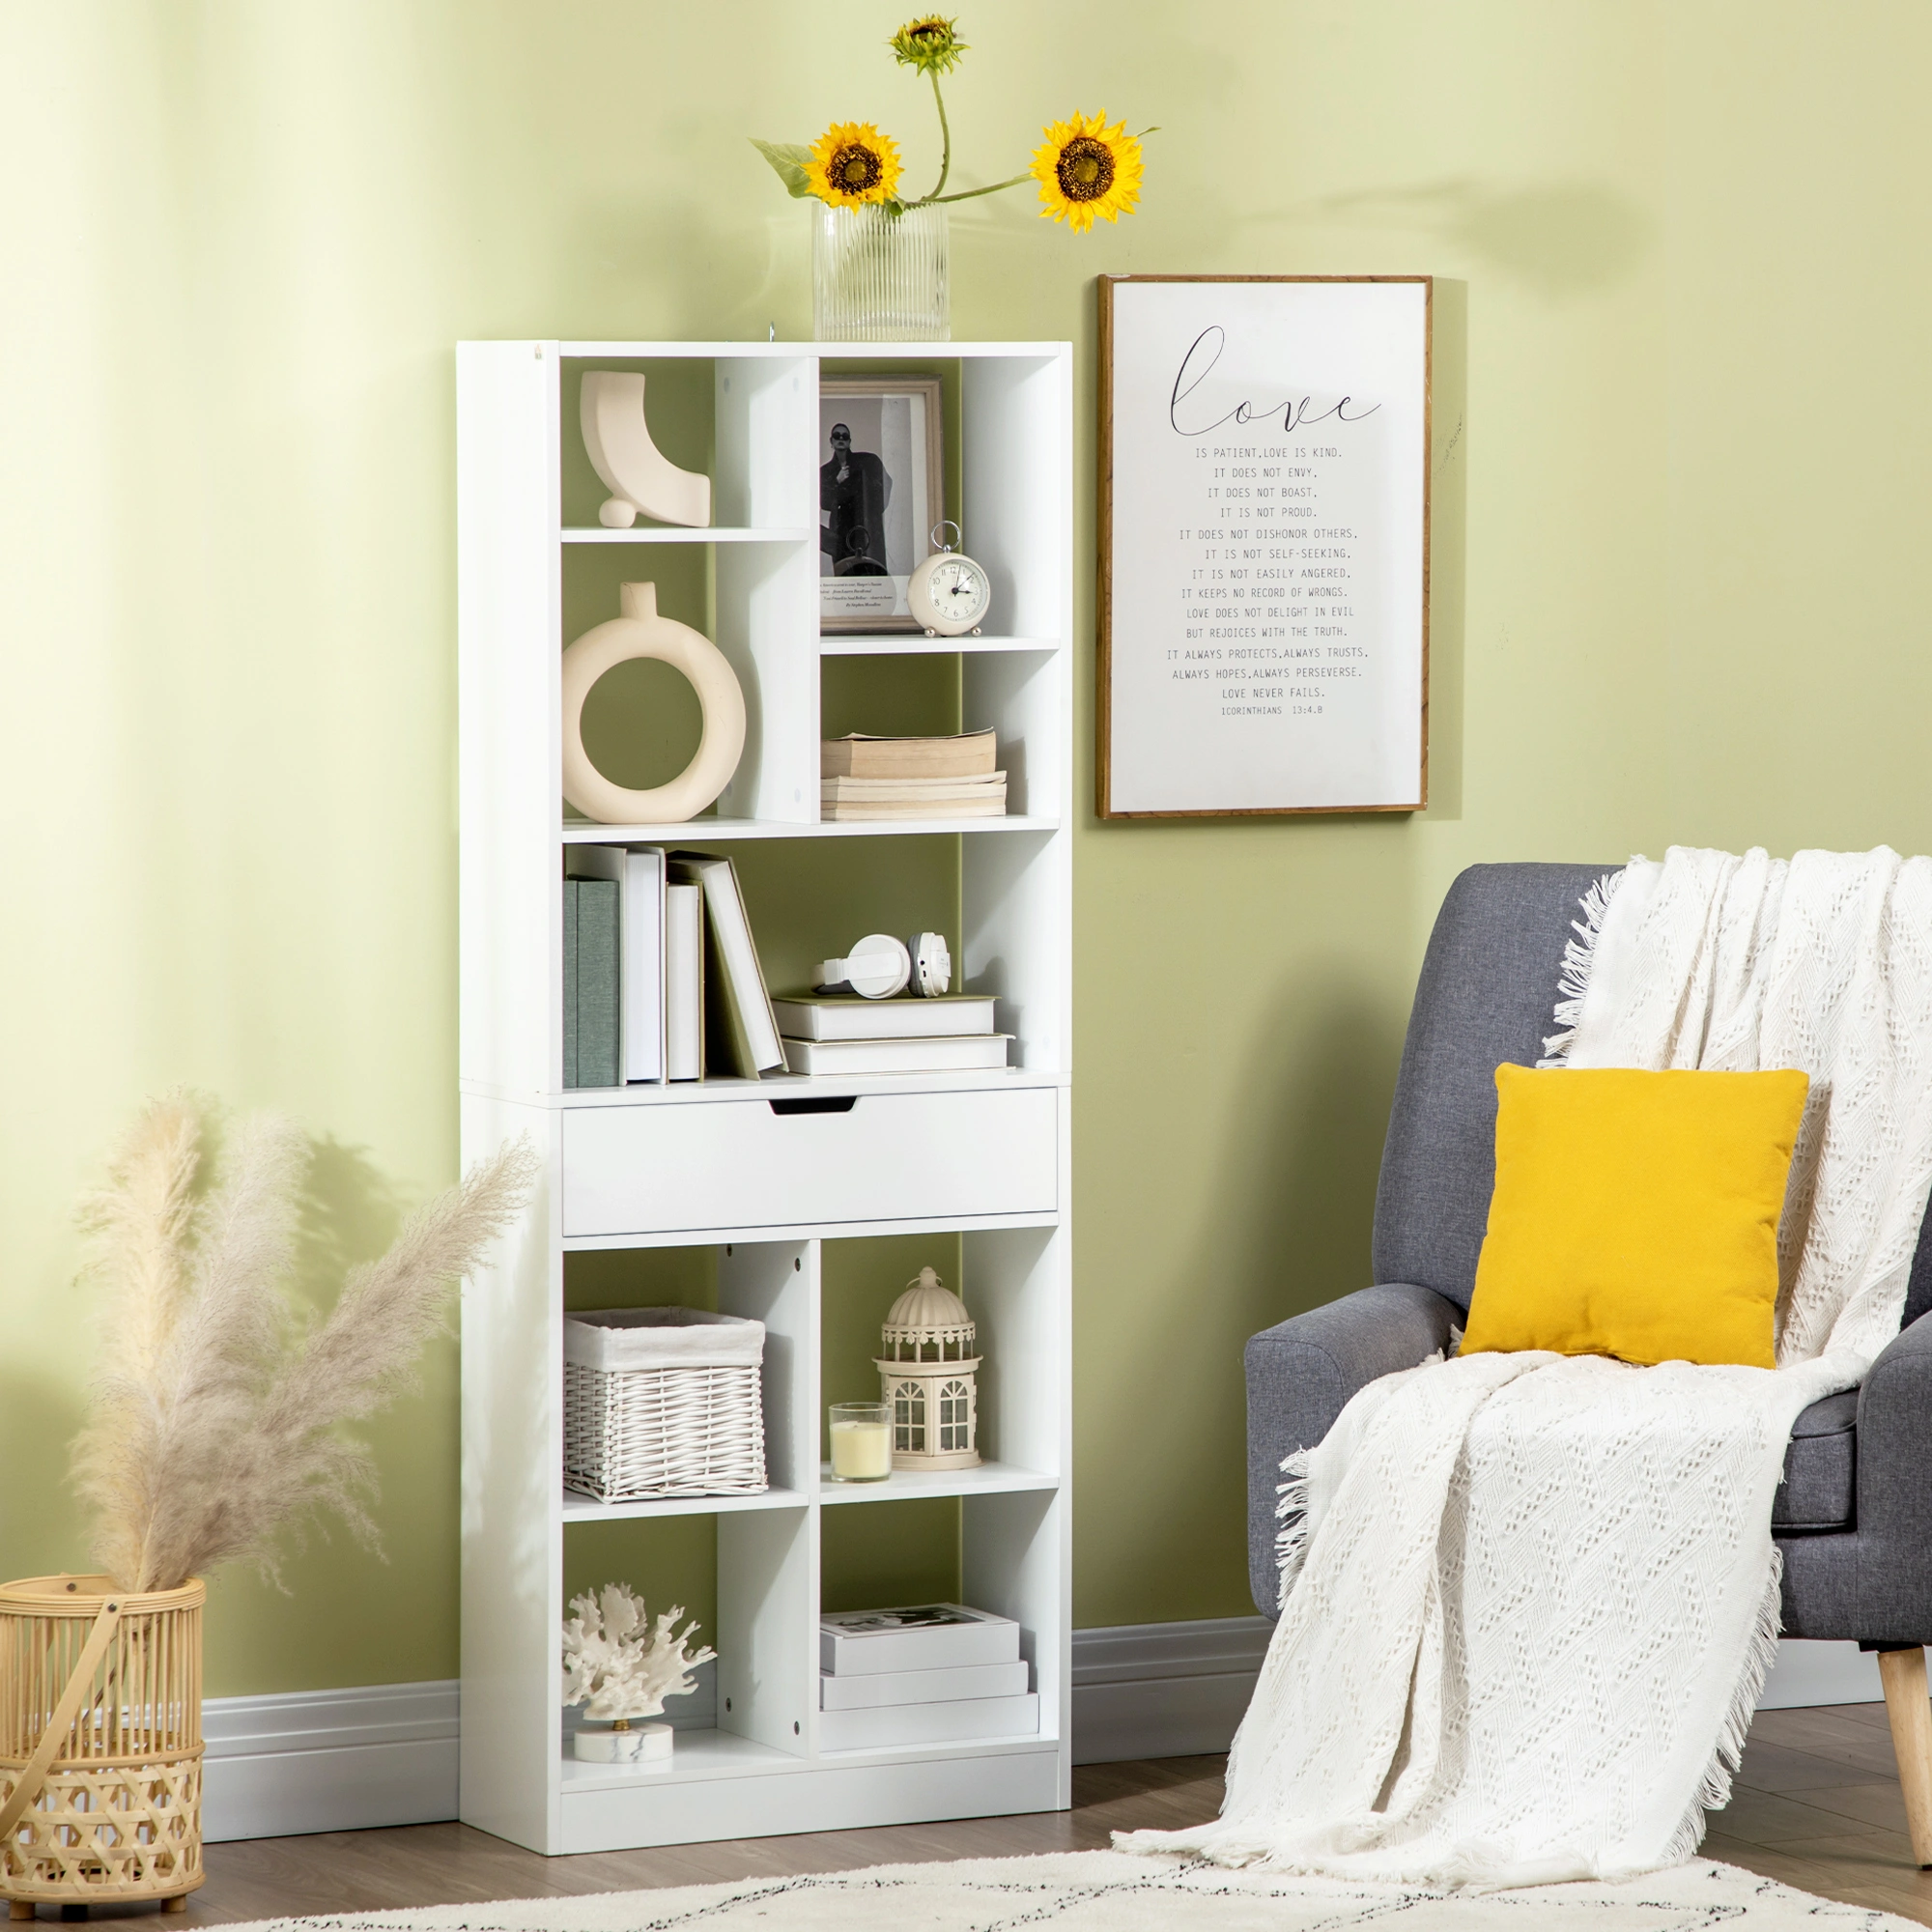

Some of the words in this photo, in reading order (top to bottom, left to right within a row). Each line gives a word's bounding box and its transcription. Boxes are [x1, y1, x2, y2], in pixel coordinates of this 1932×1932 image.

[1170, 325, 1382, 436] love
[1195, 447, 1208, 459] IS
[1294, 446, 1307, 458] IS
[1213, 467, 1226, 478] IT
[1232, 467, 1258, 479] DOES
[1263, 467, 1282, 478] NOT
[1208, 487, 1220, 498] IT
[1226, 487, 1251, 498] DOES
[1257, 487, 1276, 498] NOT
[1220, 507, 1233, 519] IT
[1238, 506, 1251, 519] IS
[1257, 506, 1275, 519] NOT
[1179, 529, 1192, 540] IT
[1198, 528, 1224, 540] DOES
[1230, 528, 1249, 540] NOT
[1256, 528, 1308, 540] DISHONOR
[1205, 549, 1217, 560] IT
[1225, 549, 1237, 560] IS
[1242, 548, 1263, 560] NOT
[1192, 569, 1205, 581] IT
[1211, 568, 1224, 580] IS
[1230, 568, 1249, 580] NOT
[1256, 568, 1294, 580] EASILY
[932, 577, 941, 585] 10
[1181, 588, 1193, 599] IT
[1198, 587, 1228, 599] KEEPS
[1233, 587, 1245, 599] NO
[1250, 587, 1286, 598] RECORD
[1291, 586, 1303, 598] OF
[953, 610, 958, 618] 6
[1186, 608, 1209, 619] LOVE
[1215, 607, 1239, 619] DOES
[1244, 607, 1263, 618] NOT
[1267, 606, 1309, 618] DELIGHT
[1315, 606, 1326, 617] IN
[1331, 606, 1354, 617] EVIL
[1185, 628, 1205, 639] BUT
[1209, 627, 1257, 639] REJOICES
[1262, 626, 1286, 638] WITH
[1291, 626, 1308, 638] THE
[1167, 649, 1179, 661] IT
[1184, 648, 1223, 660] ALWAYS
[1172, 668, 1210, 680] ALWAYS
[1222, 688, 1246, 699] LOVE
[1252, 687, 1284, 698] NEVER
[1221, 705, 1283, 716] 1CORINTHIANS
